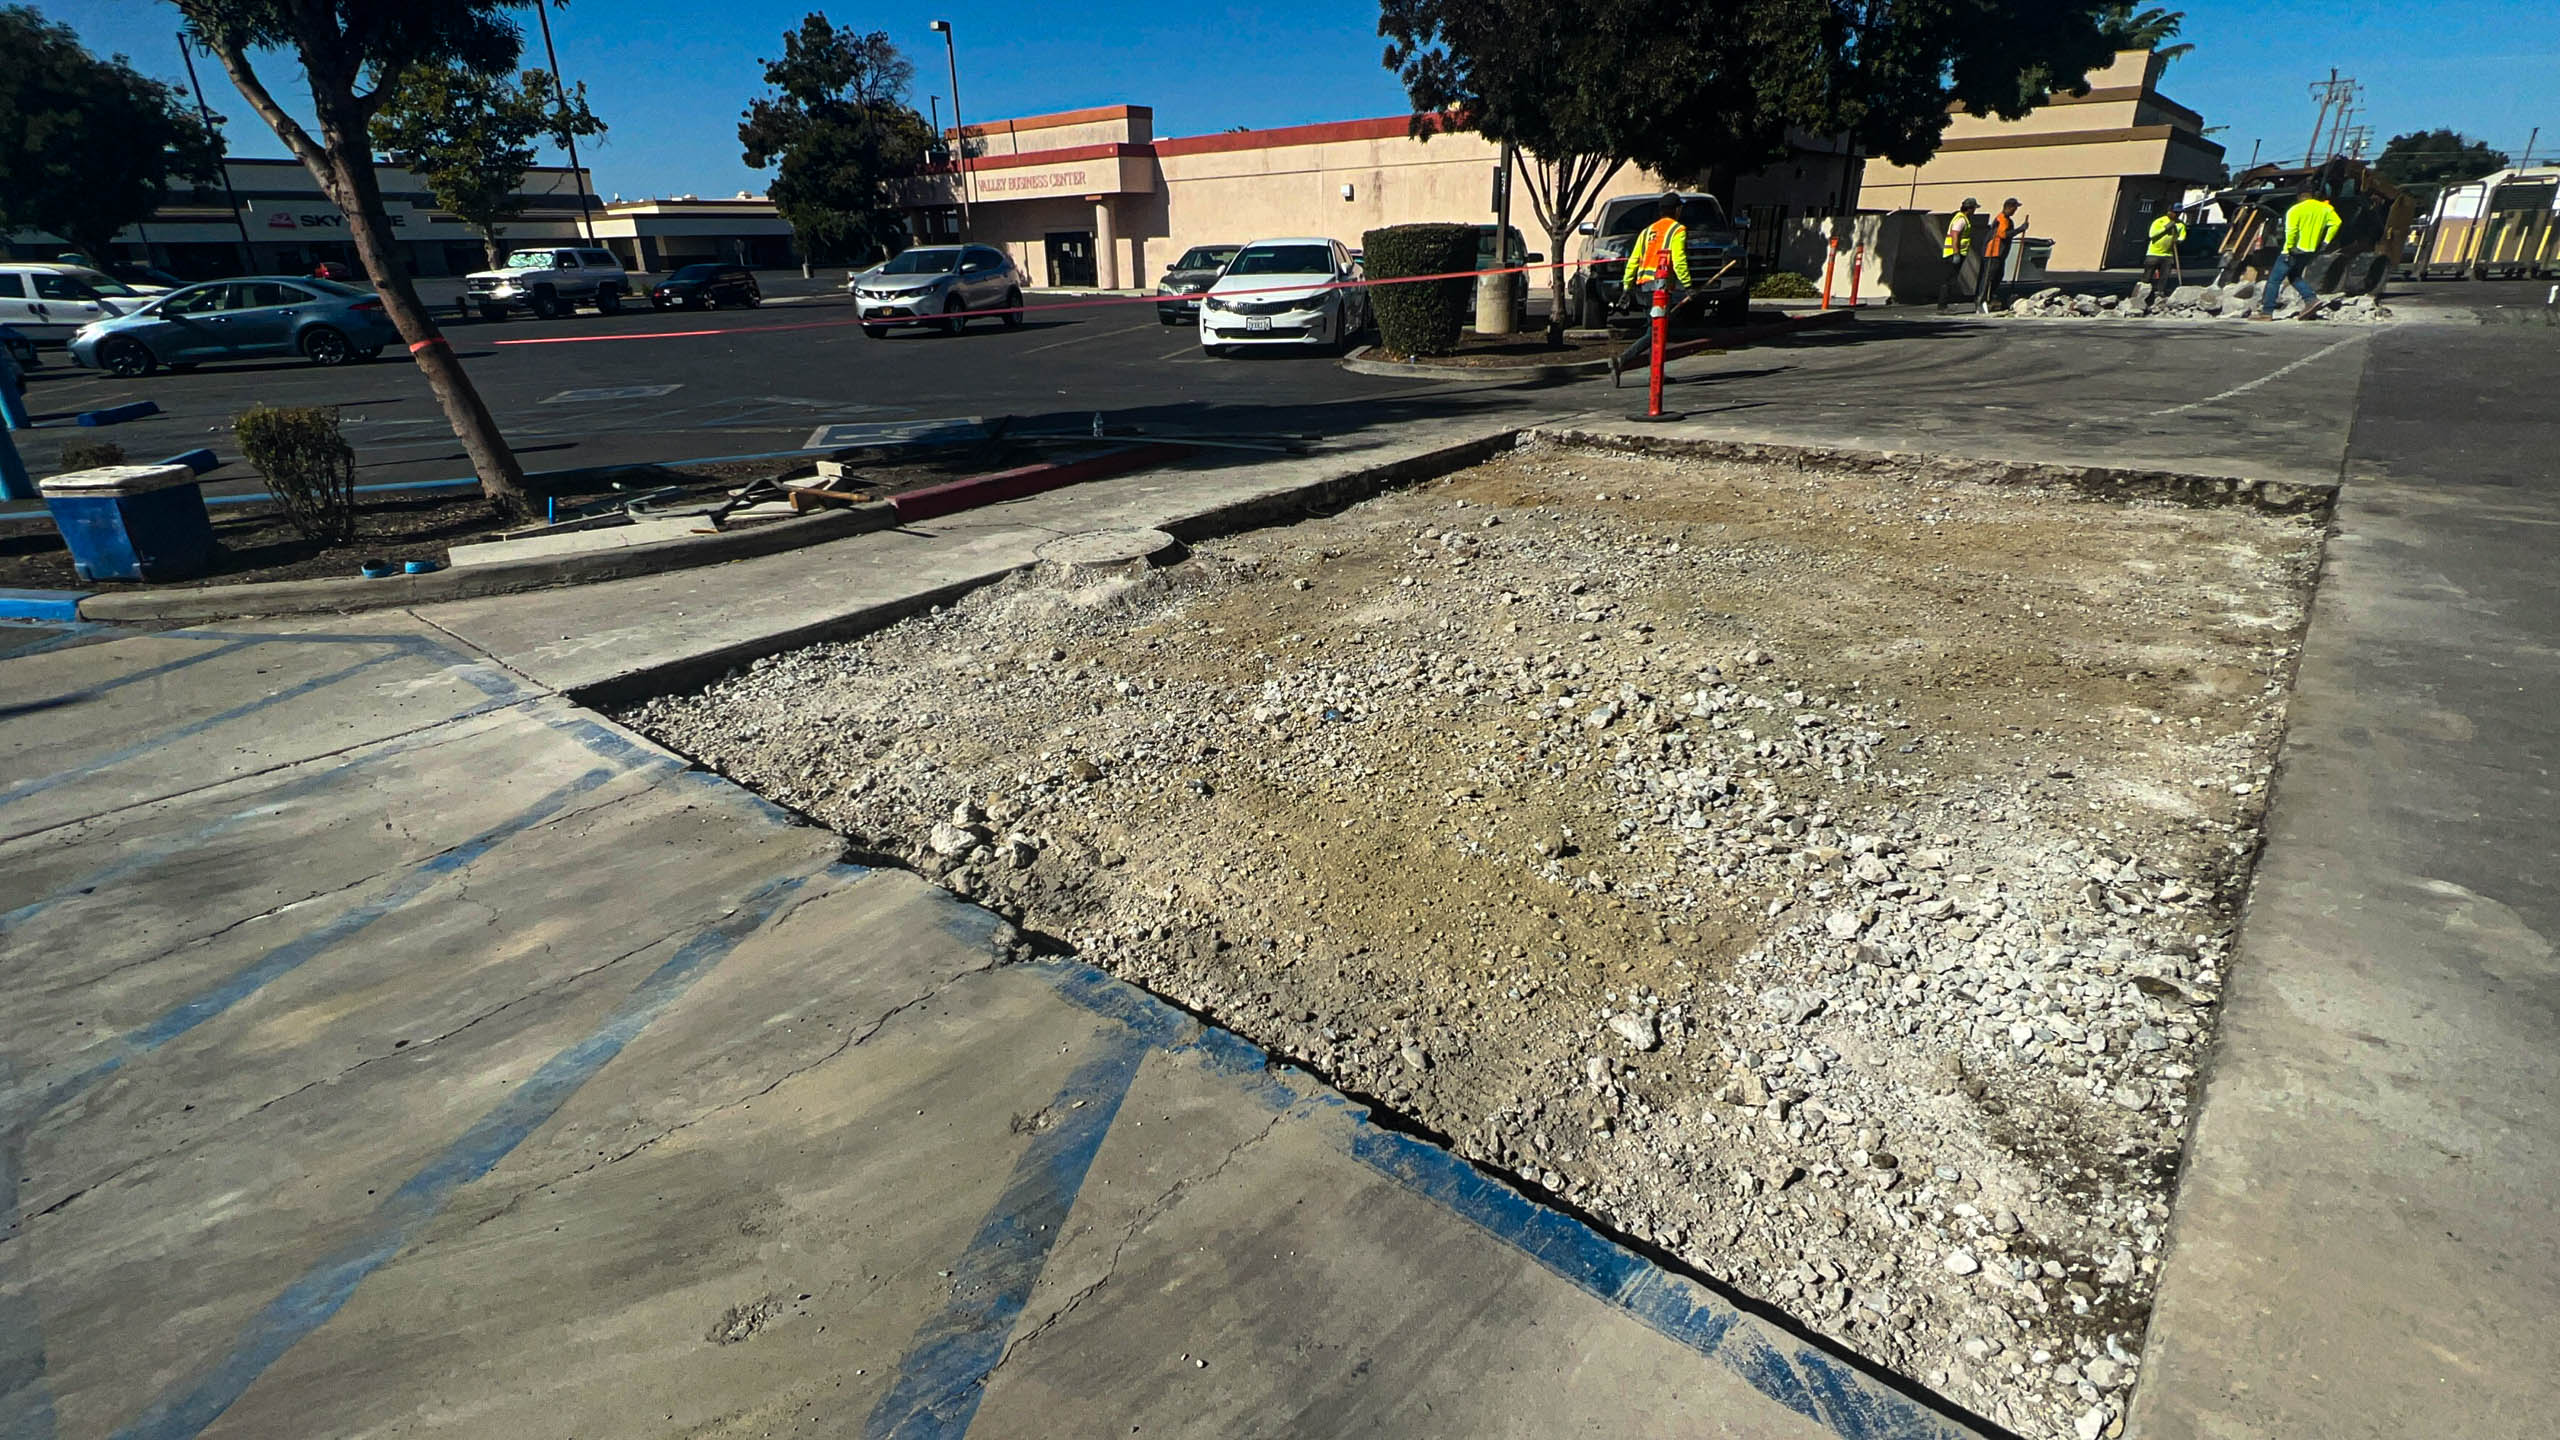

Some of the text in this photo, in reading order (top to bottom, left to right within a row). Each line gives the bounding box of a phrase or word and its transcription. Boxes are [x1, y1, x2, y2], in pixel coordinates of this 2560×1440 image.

[978, 171, 1086, 192] VALLEY BUSINESS CENTER
